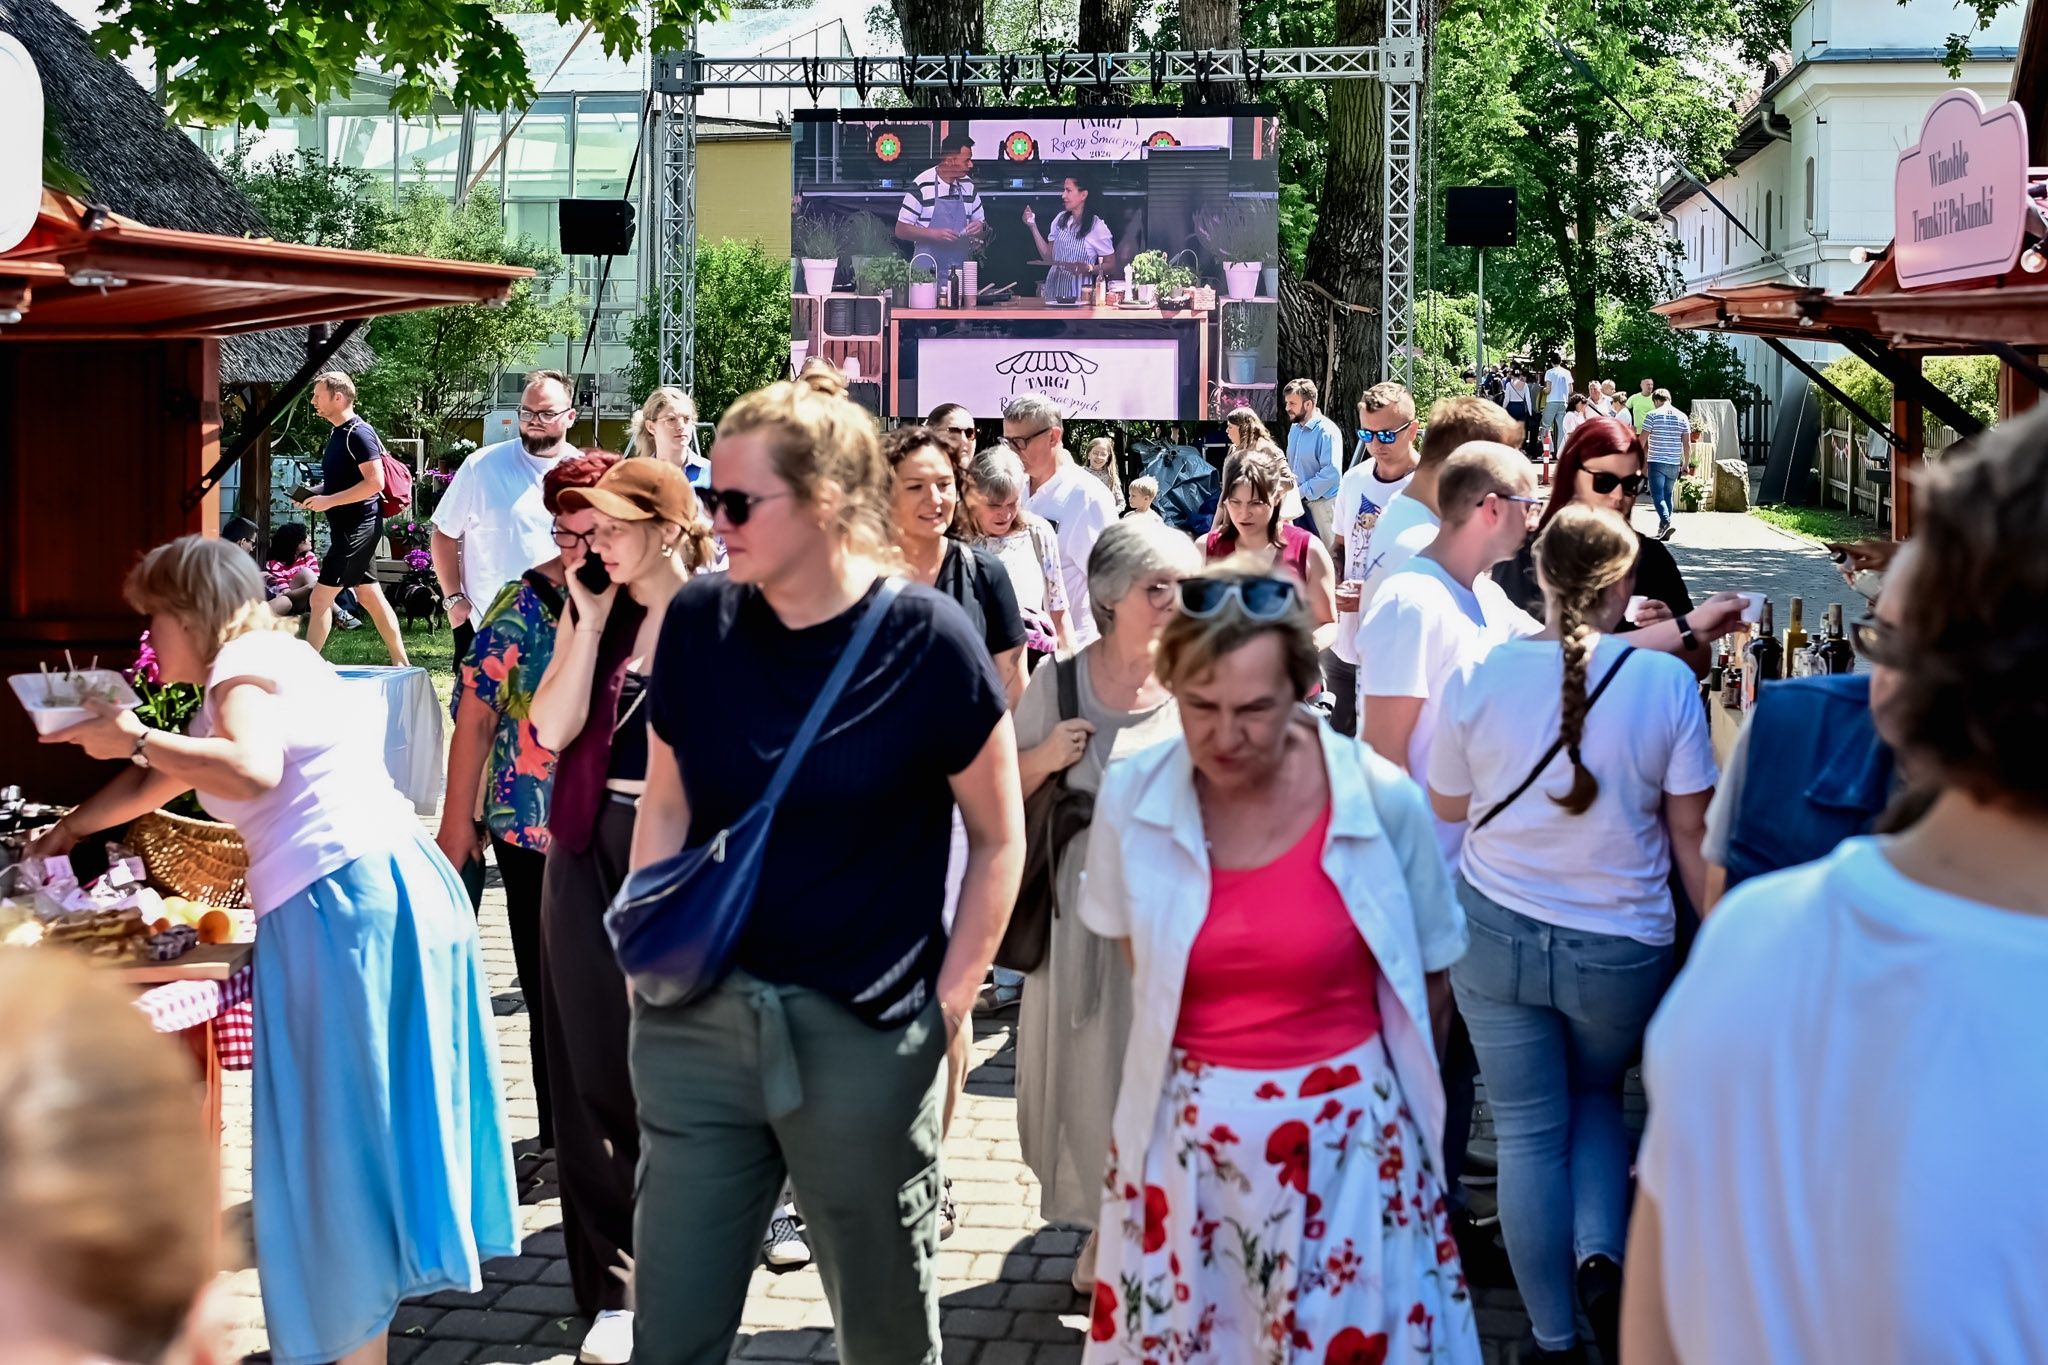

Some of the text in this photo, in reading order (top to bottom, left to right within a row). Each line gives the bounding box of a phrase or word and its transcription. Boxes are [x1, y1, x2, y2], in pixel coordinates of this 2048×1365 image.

[1052, 130, 1141, 153] Rzeczy Smaczny
[1929, 140, 1969, 188] Winoble
[1912, 201, 1942, 242] Trunki
[1949, 185, 1993, 234] Pakunki
[1025, 376, 1069, 389] TARGI
